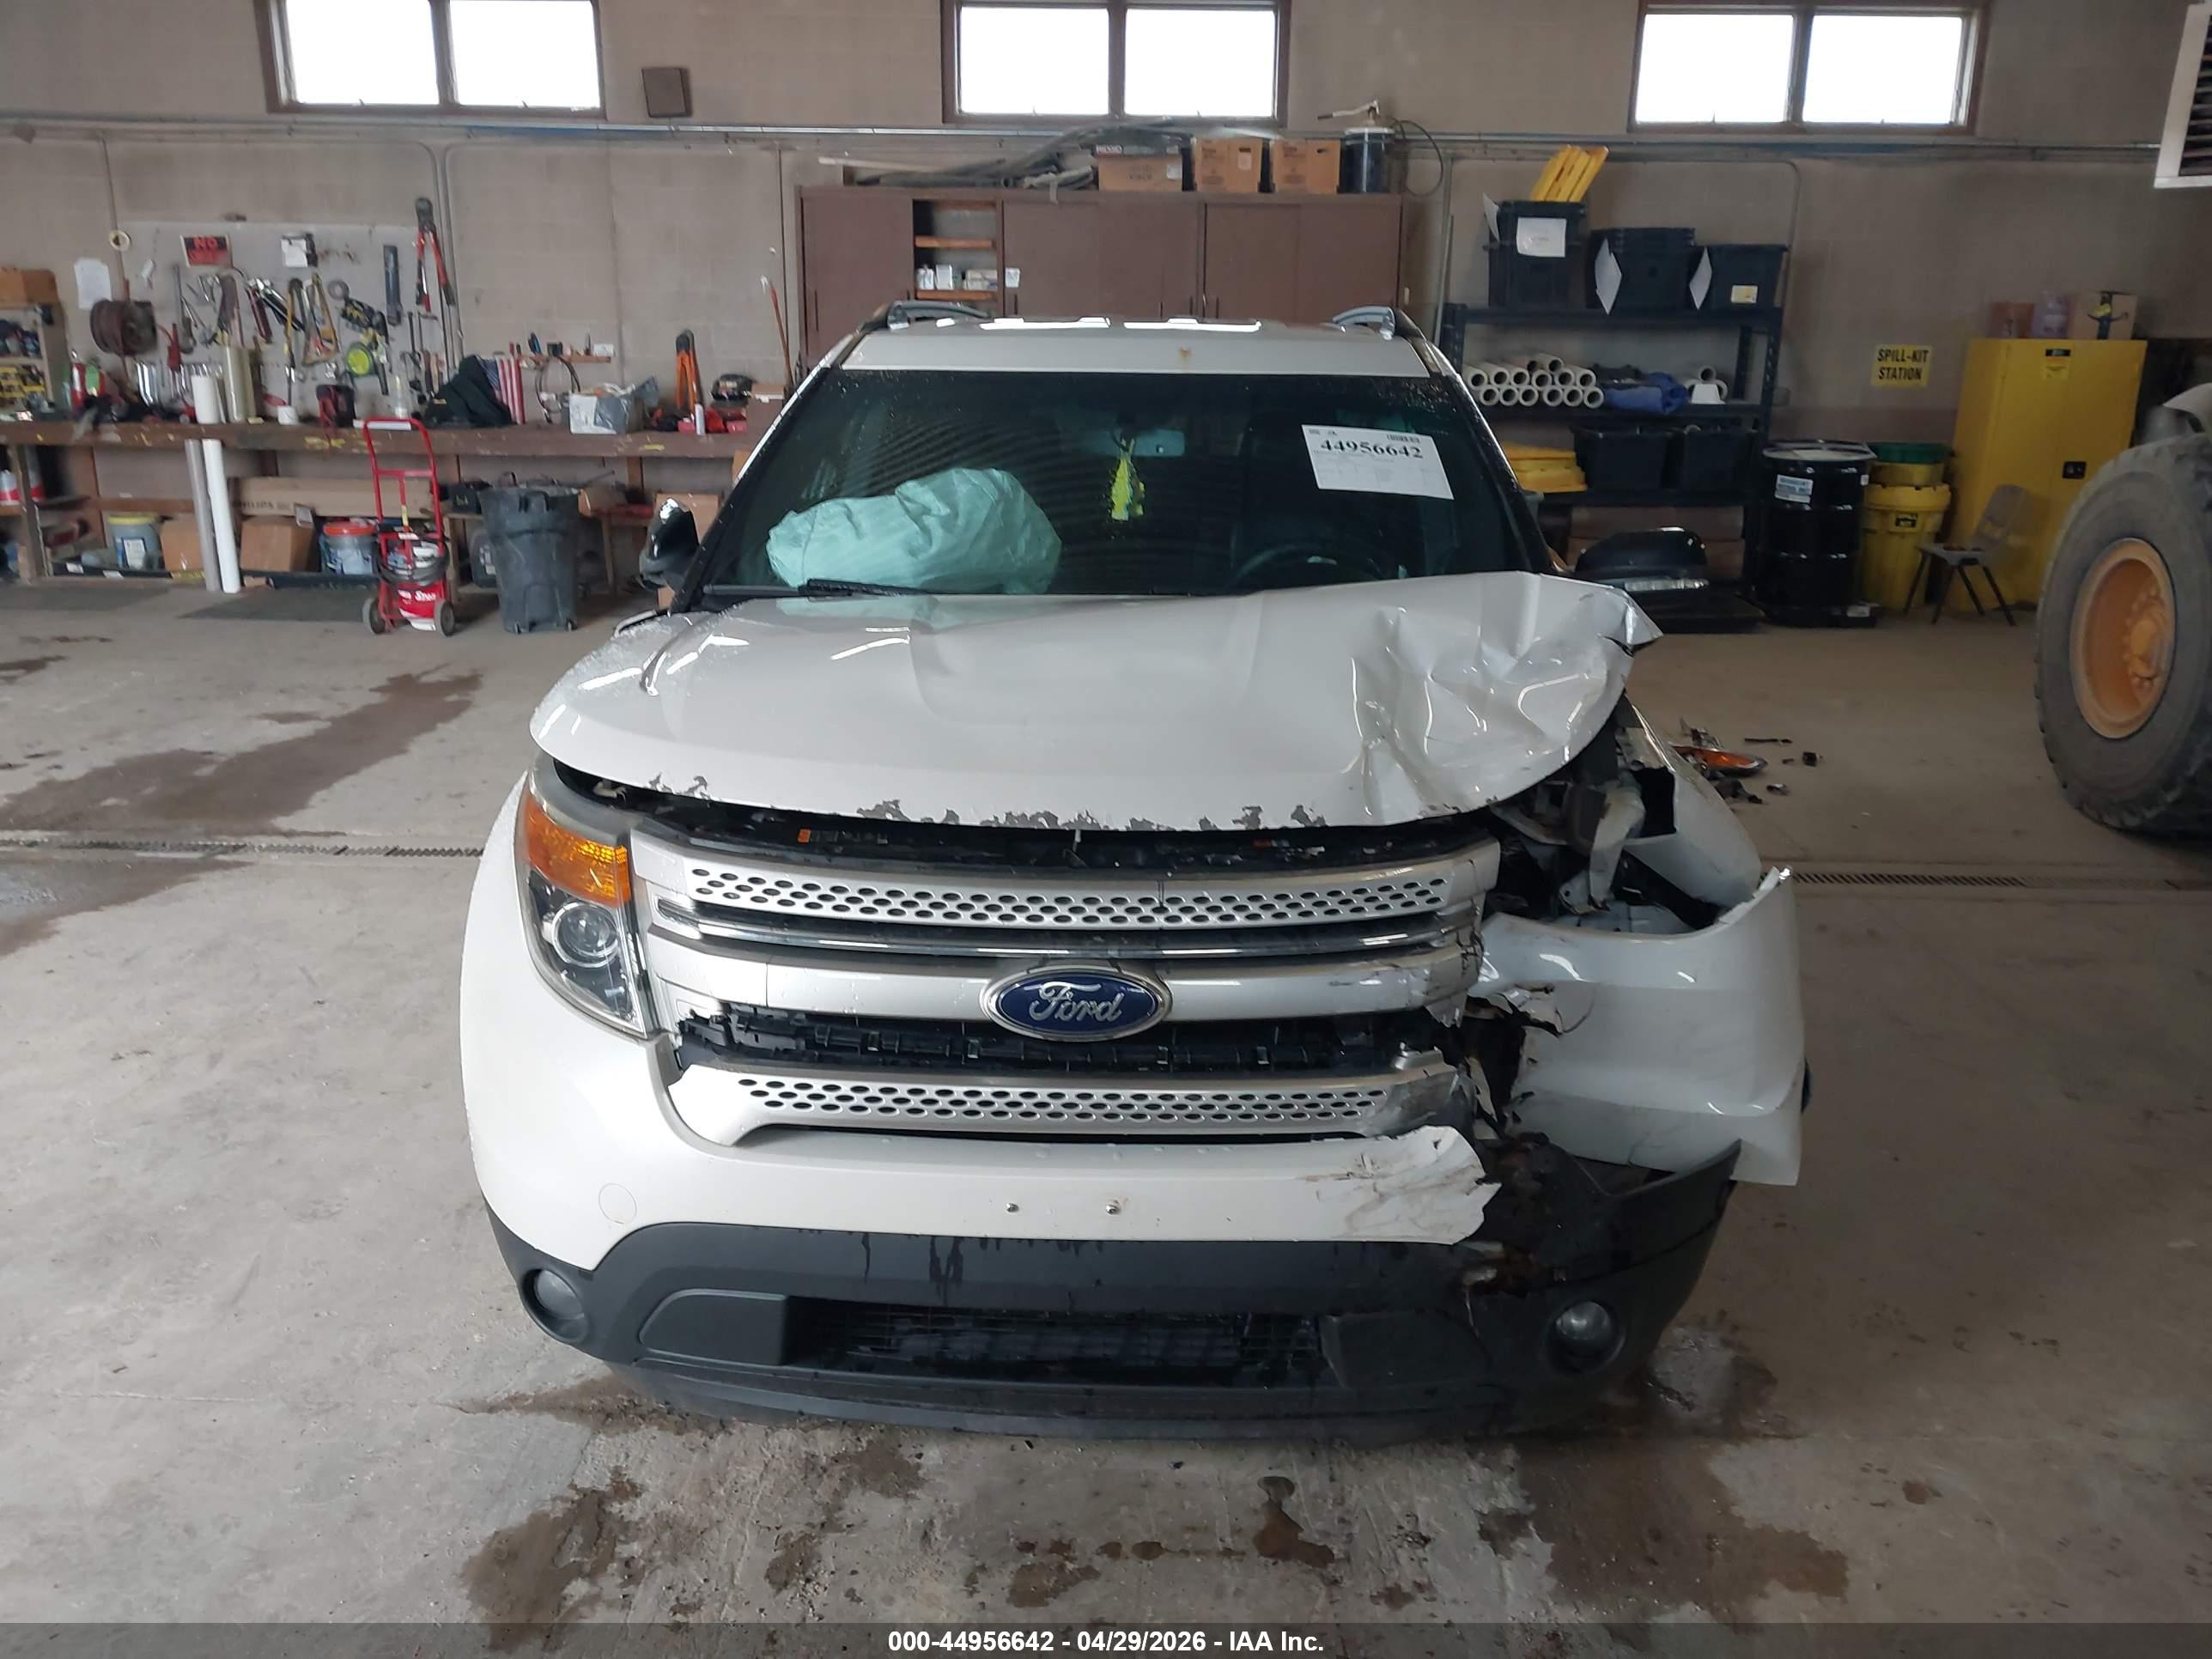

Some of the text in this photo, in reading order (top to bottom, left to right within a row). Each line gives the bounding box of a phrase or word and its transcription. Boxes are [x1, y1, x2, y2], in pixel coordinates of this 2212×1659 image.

[193, 234, 218, 248] NO
[1877, 349, 1929, 362] SPILL-KIT
[1878, 367, 1923, 380] STATION
[1321, 439, 1424, 459] 44956642
[1024, 981, 1124, 1022] Ford
